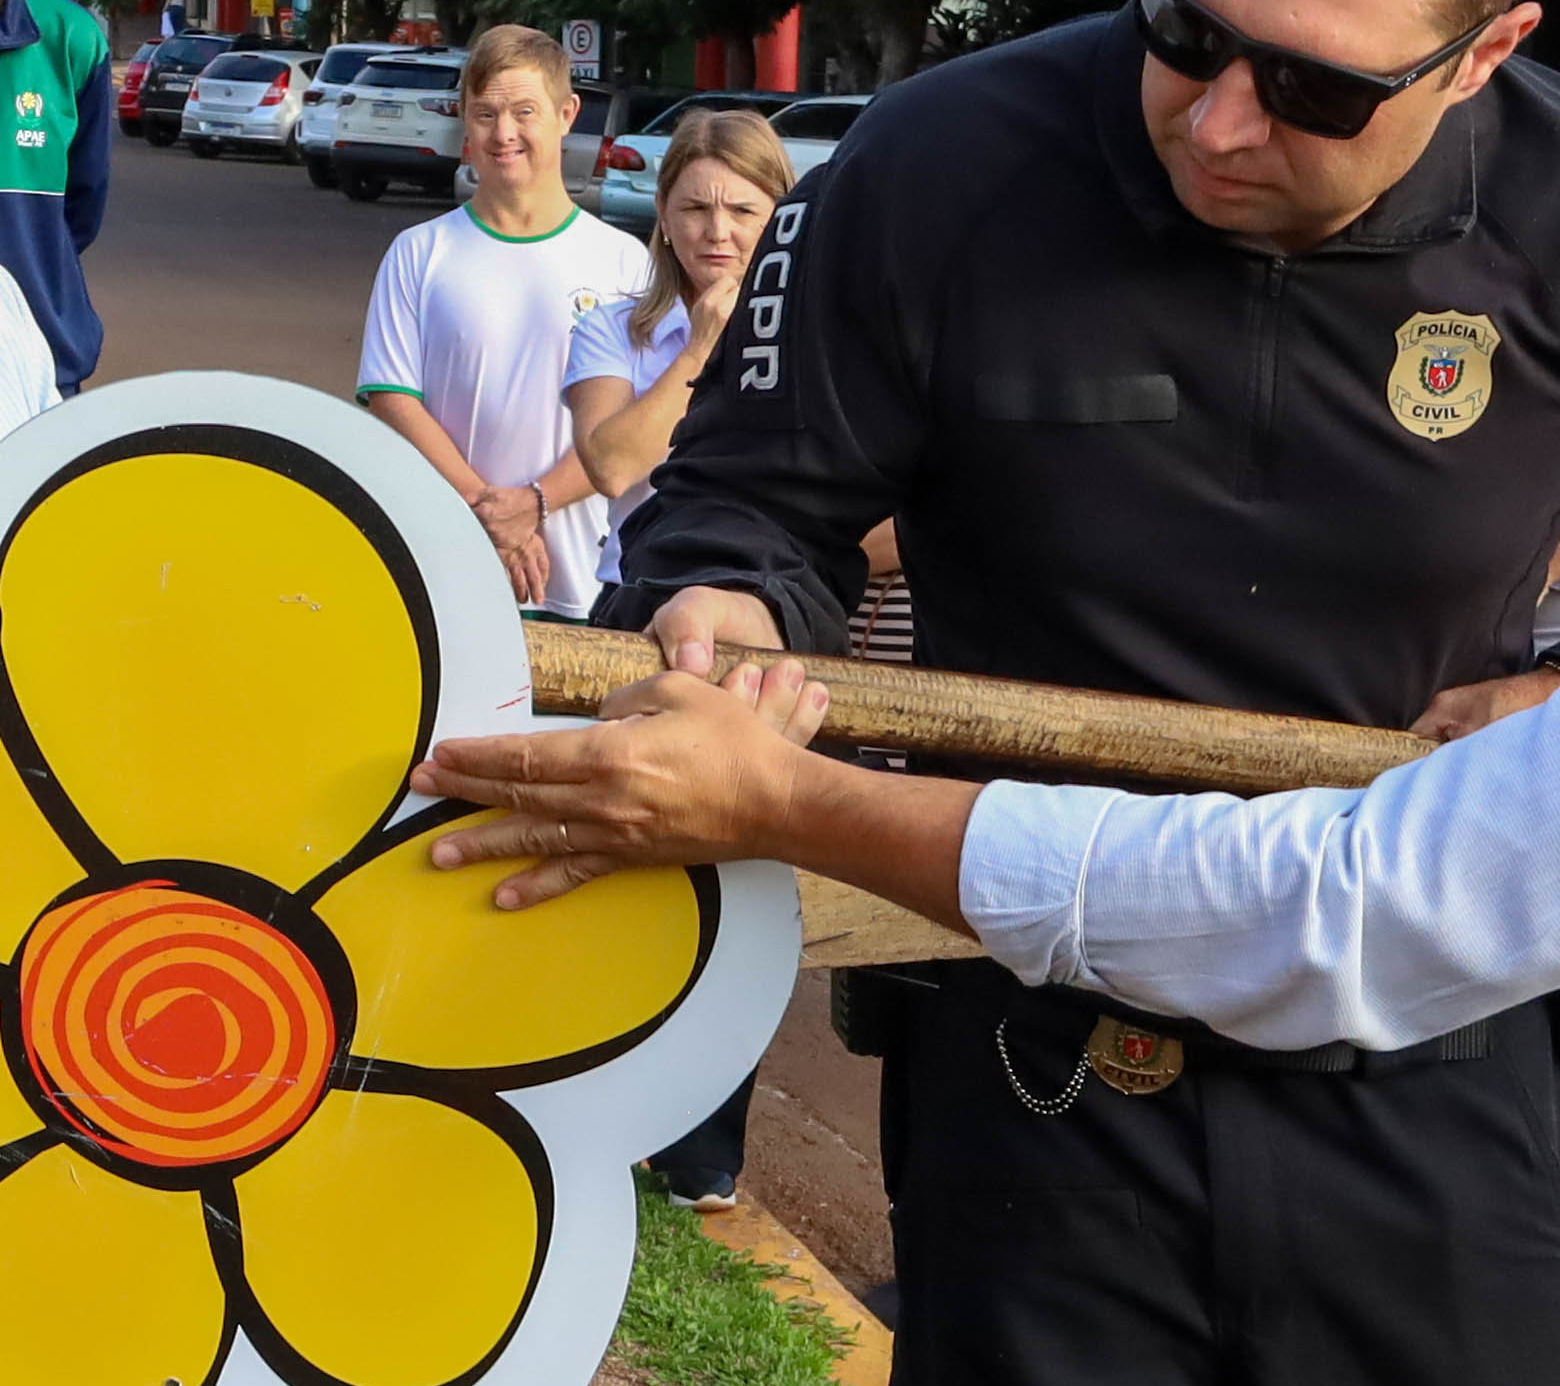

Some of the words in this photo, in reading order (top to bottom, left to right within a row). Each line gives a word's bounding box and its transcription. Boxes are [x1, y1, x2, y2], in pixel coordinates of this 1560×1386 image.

[16, 129, 46, 142] APAE
[740, 202, 808, 392] PCPR
[1418, 322, 1478, 340] POLÍCIA
[1412, 405, 1460, 419] CIVIL
